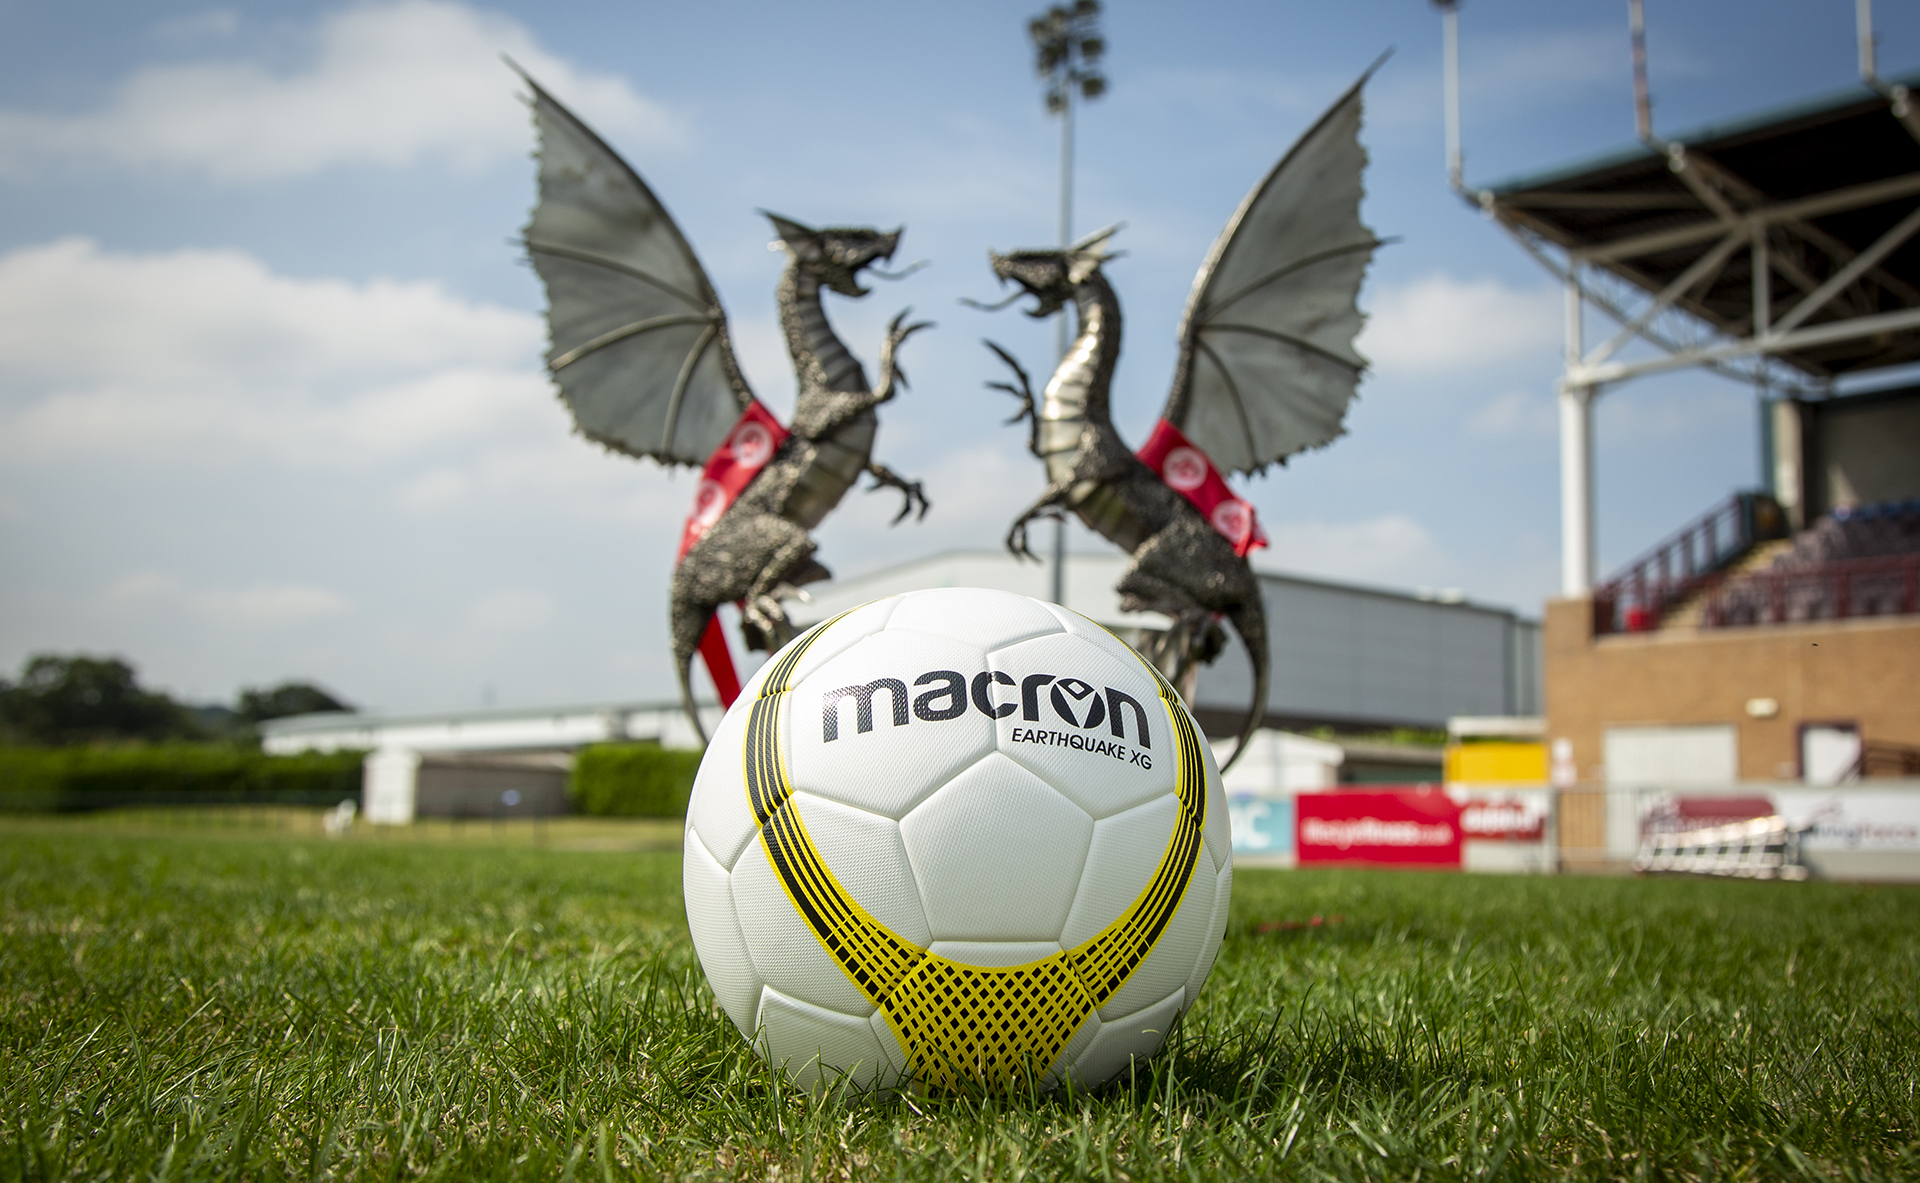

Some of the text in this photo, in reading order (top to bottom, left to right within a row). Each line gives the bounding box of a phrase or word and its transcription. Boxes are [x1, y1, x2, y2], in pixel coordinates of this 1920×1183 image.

[823, 670, 1151, 750] macron
[1012, 727, 1152, 770] EARTHQUAKE XG
